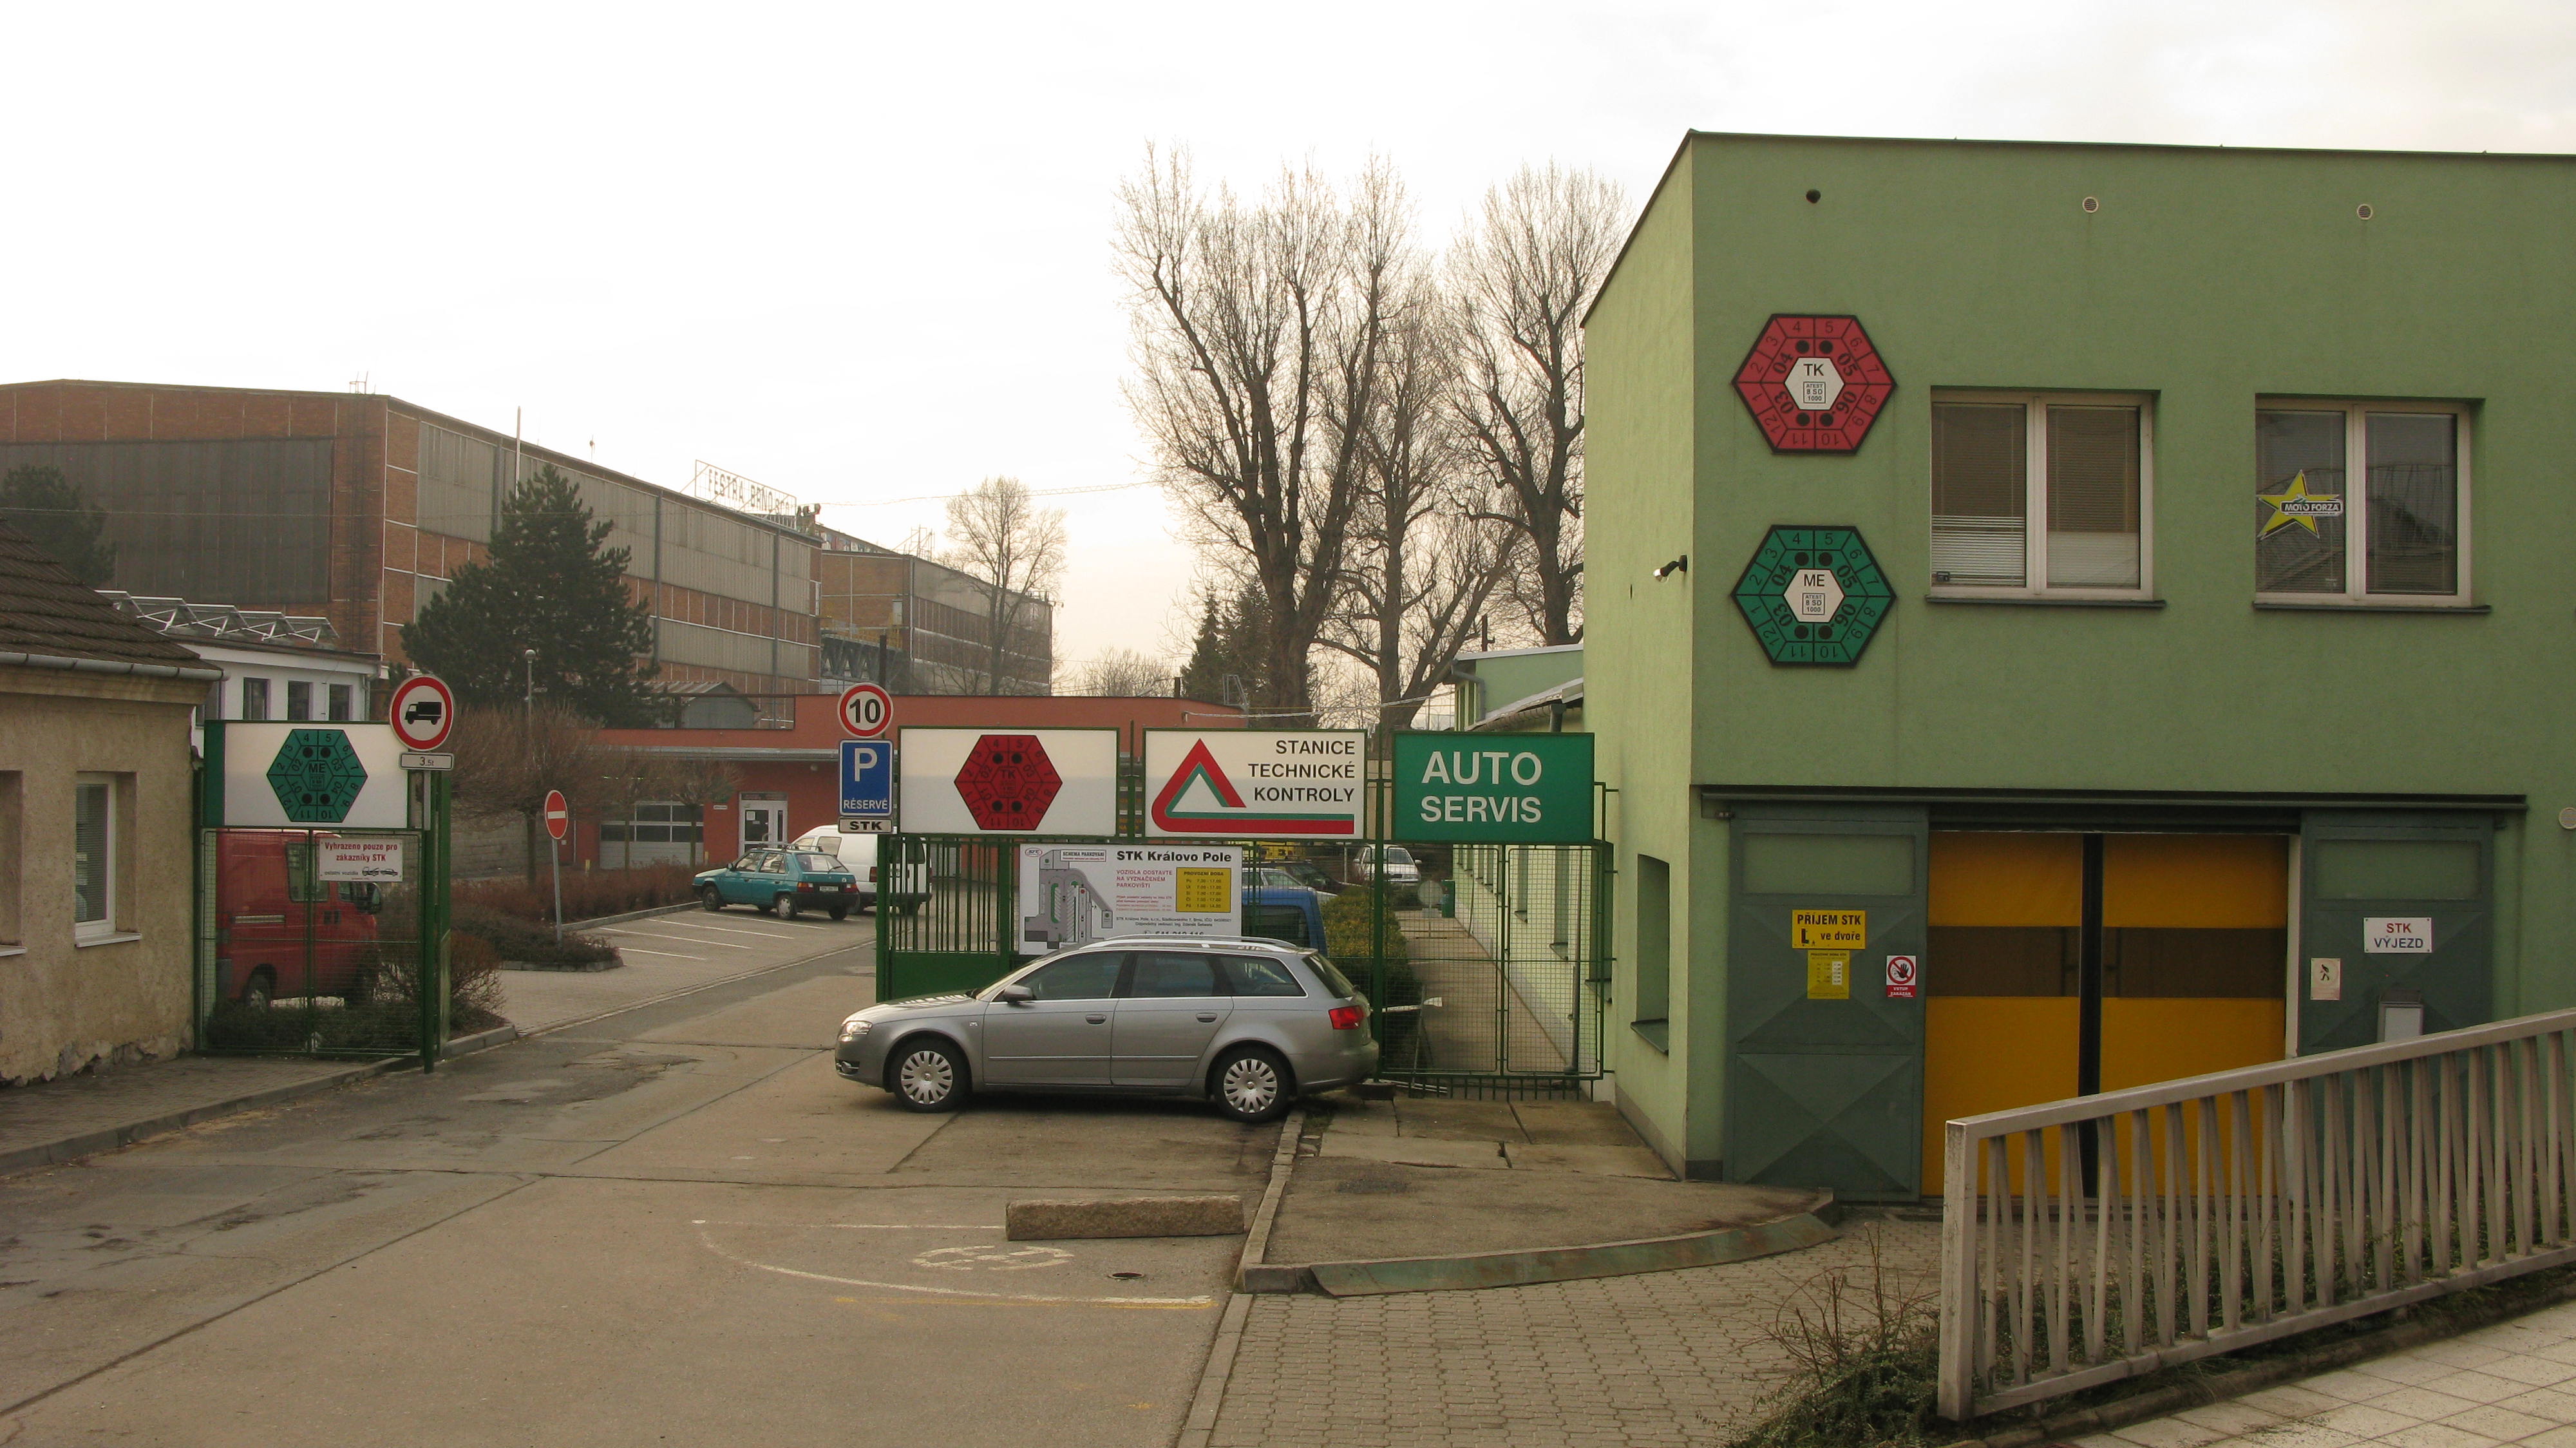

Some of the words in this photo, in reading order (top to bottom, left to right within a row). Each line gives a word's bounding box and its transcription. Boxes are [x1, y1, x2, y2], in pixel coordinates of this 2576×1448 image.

[1792, 321, 1801, 332] 4
[1825, 321, 1833, 333] 5
[1803, 363, 1824, 376] TK
[1792, 533, 1801, 544] 4
[1824, 533, 1833, 545] 5
[1772, 564, 1793, 586] 04
[1804, 574, 1824, 587] ME
[1837, 565, 1857, 589] 05
[849, 699, 880, 723] 10
[1276, 740, 1355, 755] STANICE
[309, 763, 326, 773] ME
[854, 747, 878, 782] P
[1248, 761, 1355, 778] TECHNICKÉ
[1421, 751, 1542, 785] AUTO
[1255, 787, 1355, 802] KONTROLY
[844, 797, 888, 810] RÉSERVÉ
[1421, 795, 1542, 823] SERVIS
[849, 821, 883, 831] STK
[325, 843, 361, 851] Vyhrazeno
[1117, 851, 1143, 861] STK
[1148, 851, 1198, 861] Královo
[1203, 852, 1232, 862] Pole
[1797, 912, 1837, 925] PŘÍJEM
[1842, 915, 1861, 925] STK
[2387, 923, 2411, 933] STK
[1835, 931, 1861, 940] dvoře
[2374, 935, 2423, 948] VÝJEZD
